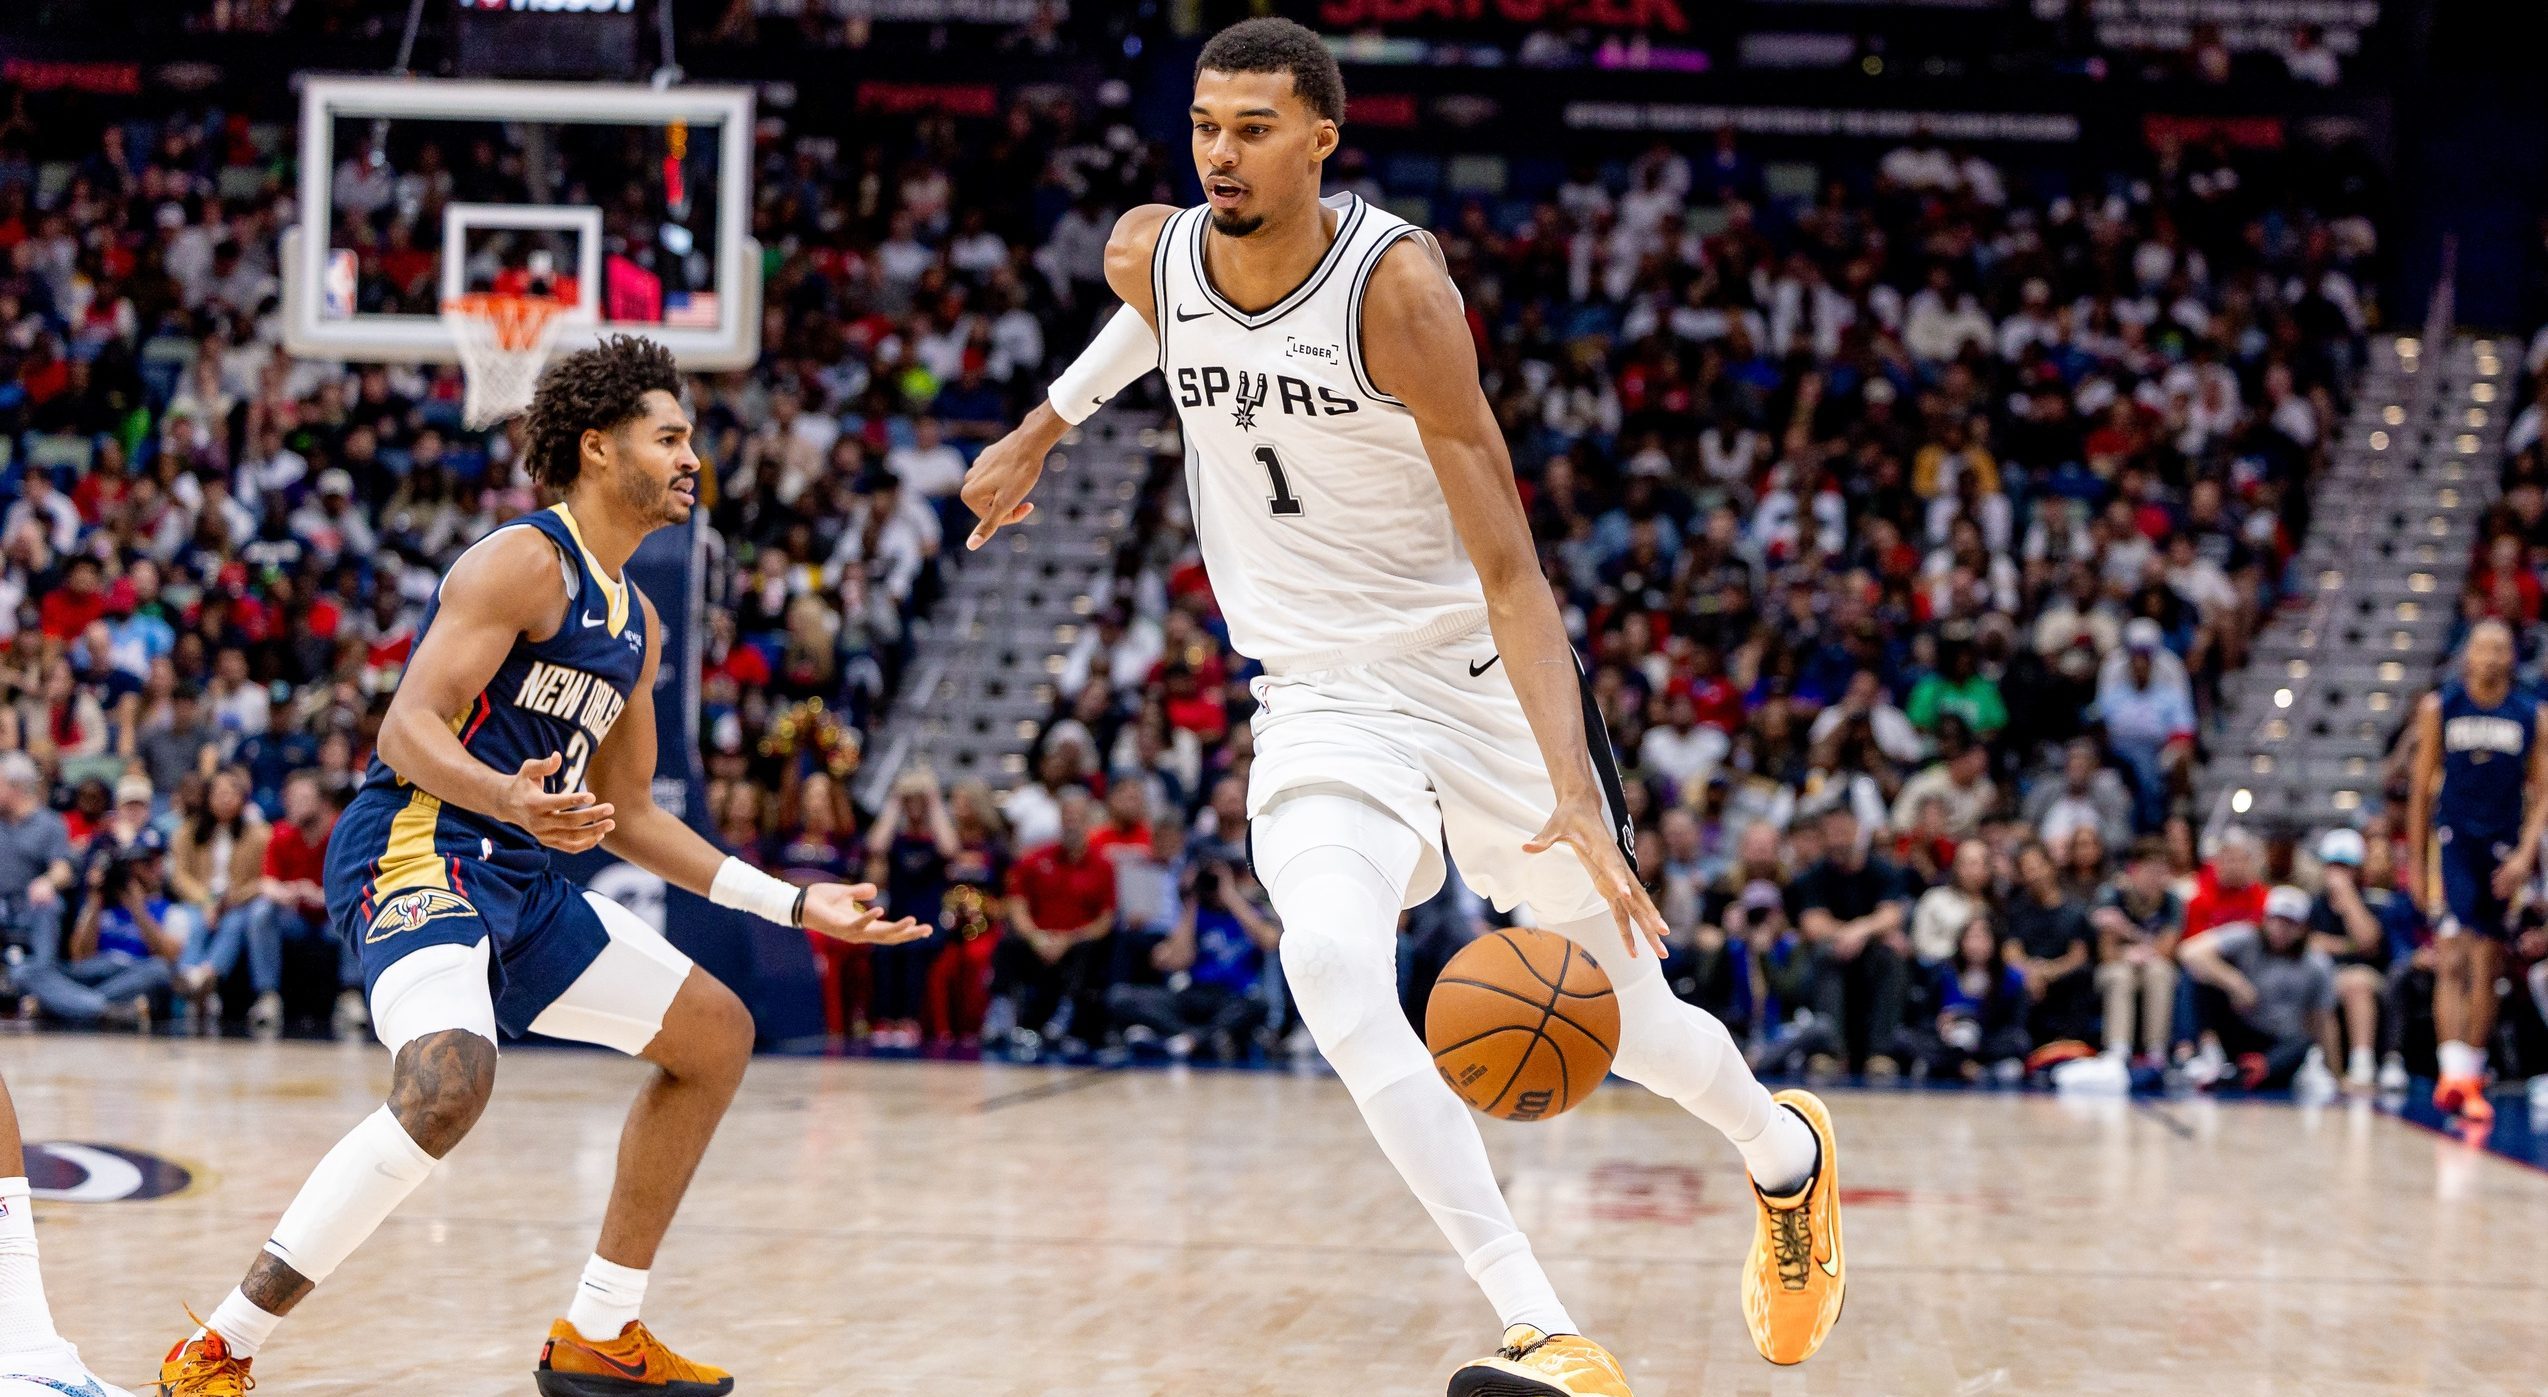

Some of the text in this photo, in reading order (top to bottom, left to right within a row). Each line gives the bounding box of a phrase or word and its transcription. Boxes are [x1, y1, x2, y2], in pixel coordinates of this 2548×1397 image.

[1292, 342, 1332, 359] LEDGER
[1177, 366, 1360, 433] SPURS
[1252, 444, 1305, 517] 1
[513, 660, 593, 721] NEW
